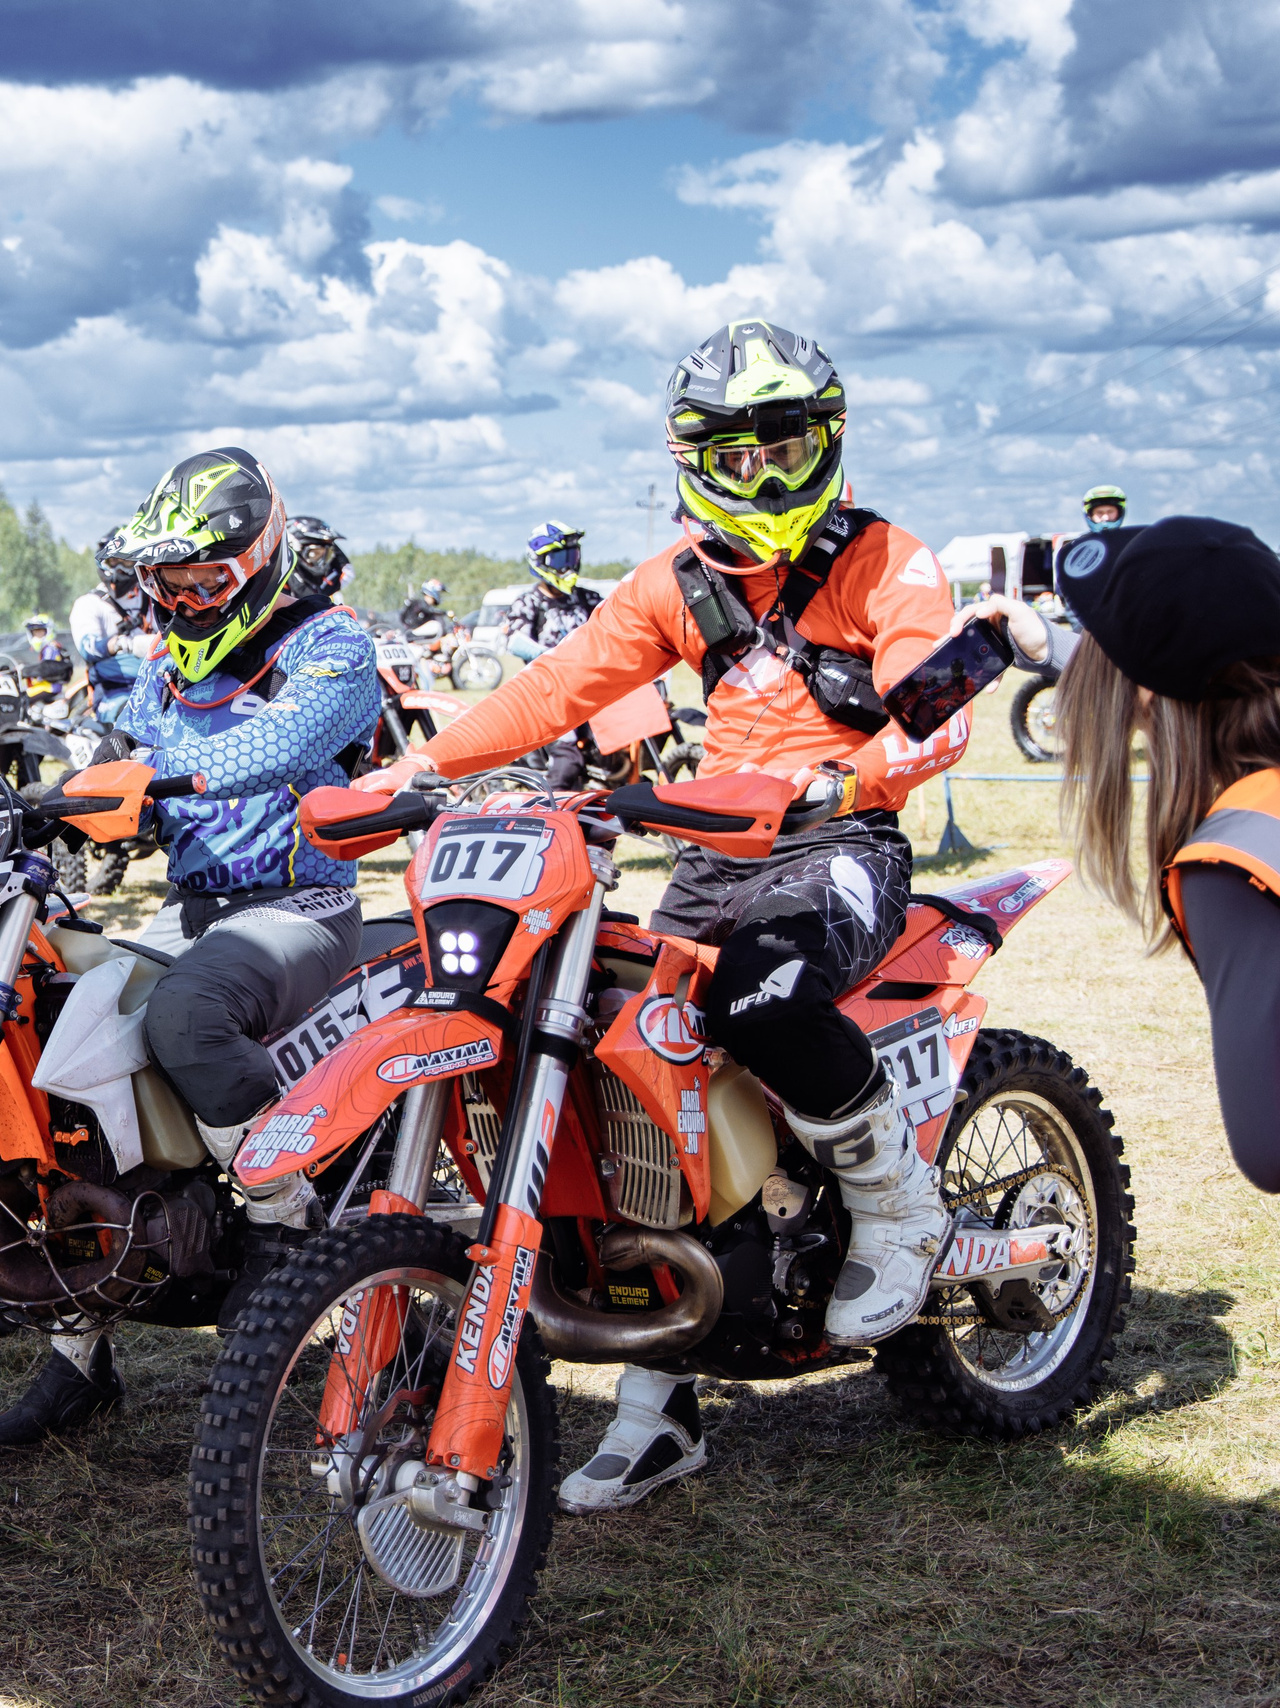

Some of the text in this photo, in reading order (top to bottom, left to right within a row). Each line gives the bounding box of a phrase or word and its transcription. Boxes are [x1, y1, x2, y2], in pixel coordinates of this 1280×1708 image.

[136, 536, 193, 559] Airoh
[885, 746, 965, 779] PLAST
[430, 840, 527, 884] 017
[522, 914, 551, 930] ENDURO
[528, 908, 549, 921] HARD
[427, 991, 456, 1000] ENDURO
[730, 990, 771, 1016] UFO
[954, 1017, 977, 1034] UFO
[276, 1012, 346, 1082] 015
[411, 1038, 492, 1070] MAXIMA
[423, 1053, 494, 1076] RACING OILS
[681, 1088, 701, 1112] HARD
[265, 1113, 316, 1135] HARD
[677, 1110, 706, 1133] ENDURO
[245, 1131, 318, 1155] ENDURO
[608, 1285, 650, 1298] ENDURO
[611, 1296, 649, 1306] ELEMENT
[455, 1264, 496, 1375] KENDA
